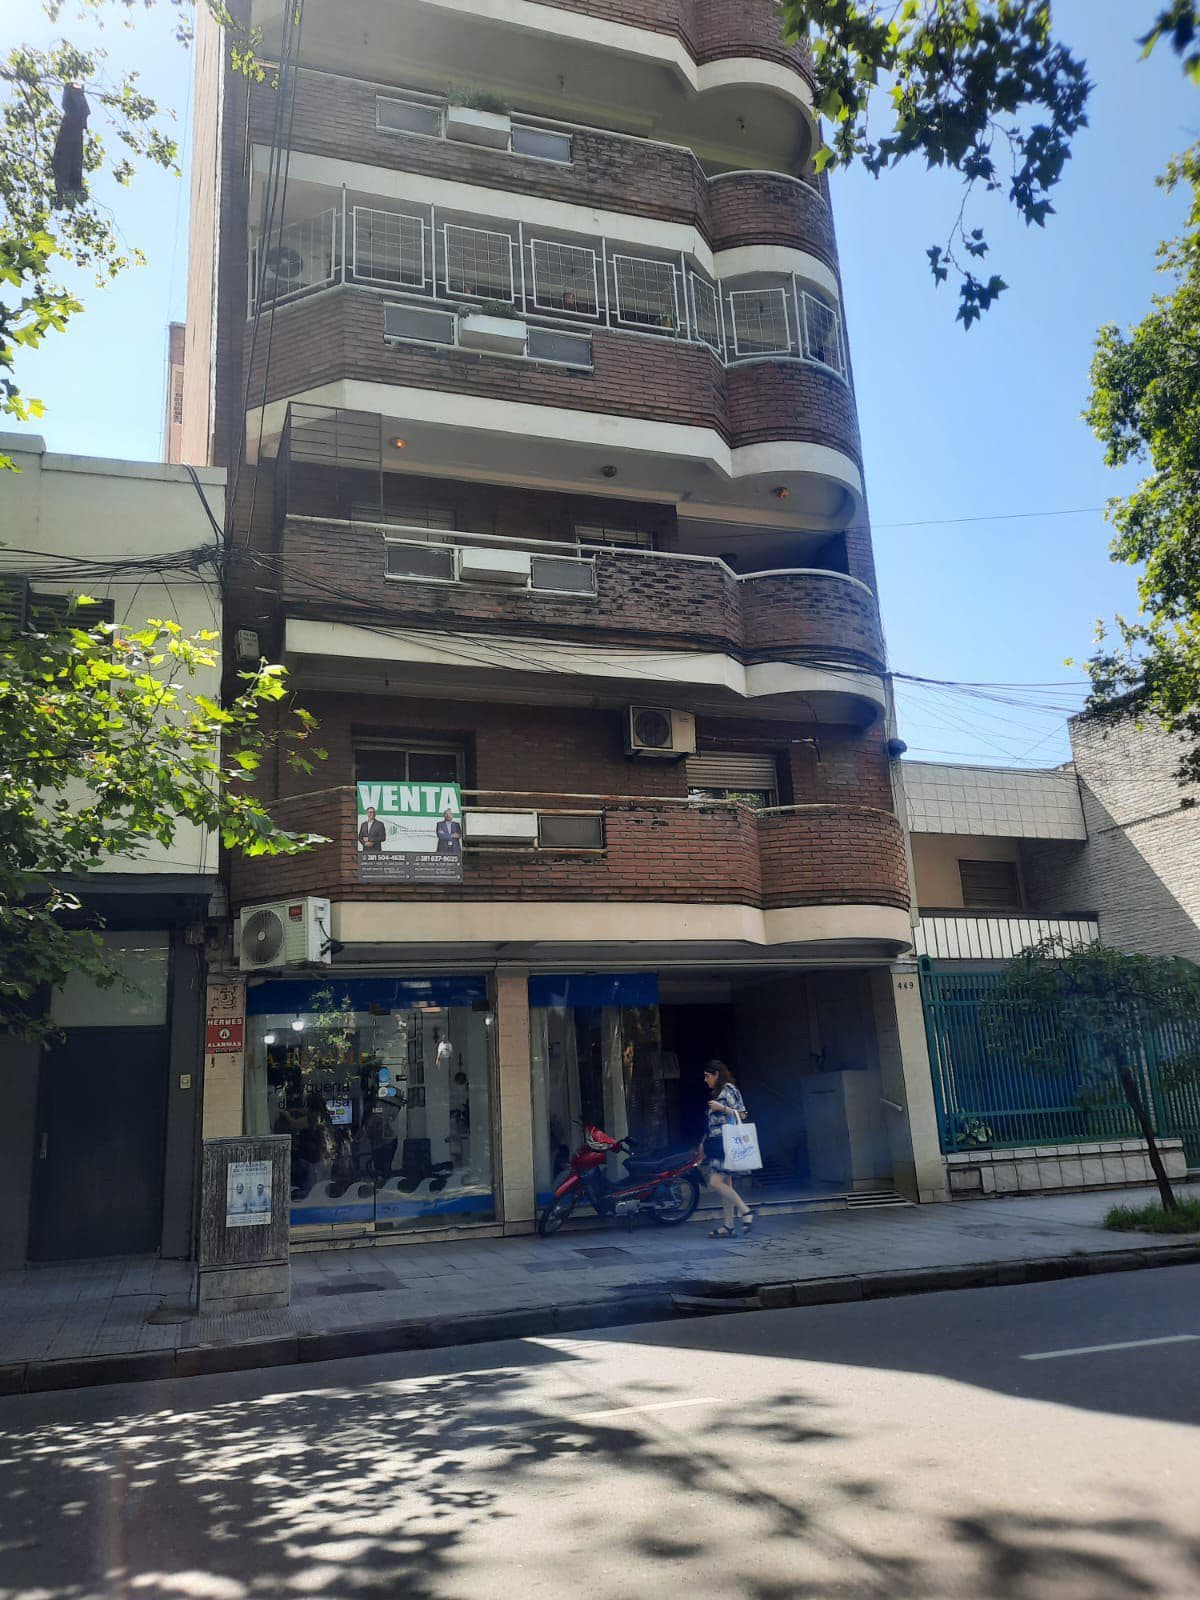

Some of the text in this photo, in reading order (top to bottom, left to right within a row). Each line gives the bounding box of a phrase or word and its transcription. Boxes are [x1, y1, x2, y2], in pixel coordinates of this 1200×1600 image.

[358, 784, 460, 814] VENTA
[897, 981, 914, 990] 449
[207, 1018, 242, 1026] HERMES
